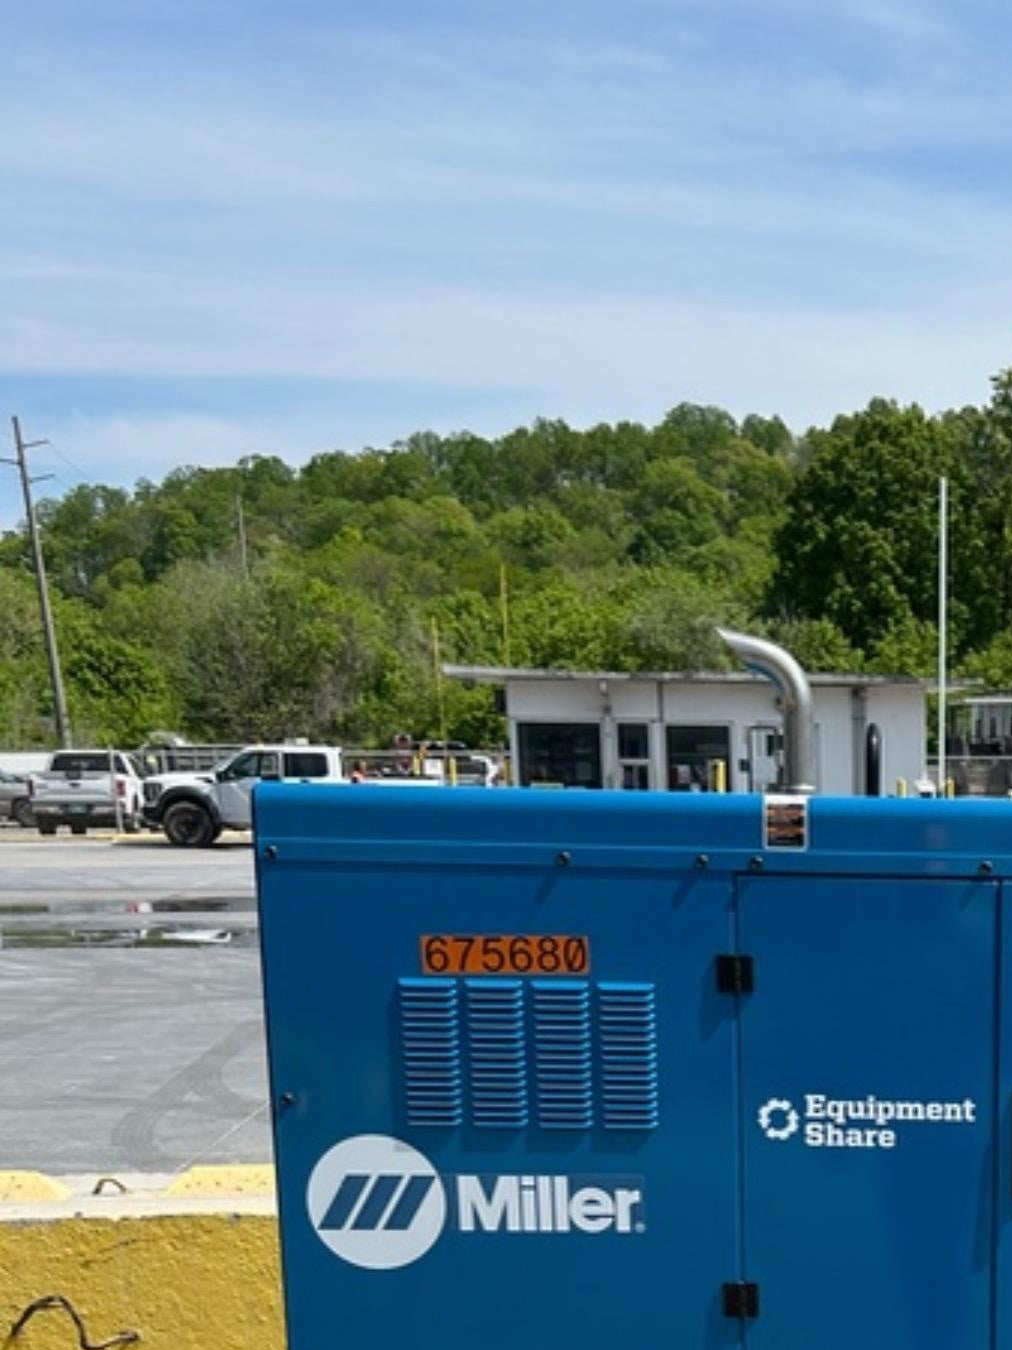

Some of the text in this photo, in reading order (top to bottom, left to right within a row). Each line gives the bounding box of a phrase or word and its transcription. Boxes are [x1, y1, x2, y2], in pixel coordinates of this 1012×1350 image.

[425, 936, 587, 973] 675680
[804, 1094, 976, 1125] Equipment
[804, 1122, 896, 1148] Share
[456, 1174, 642, 1233] Miller
